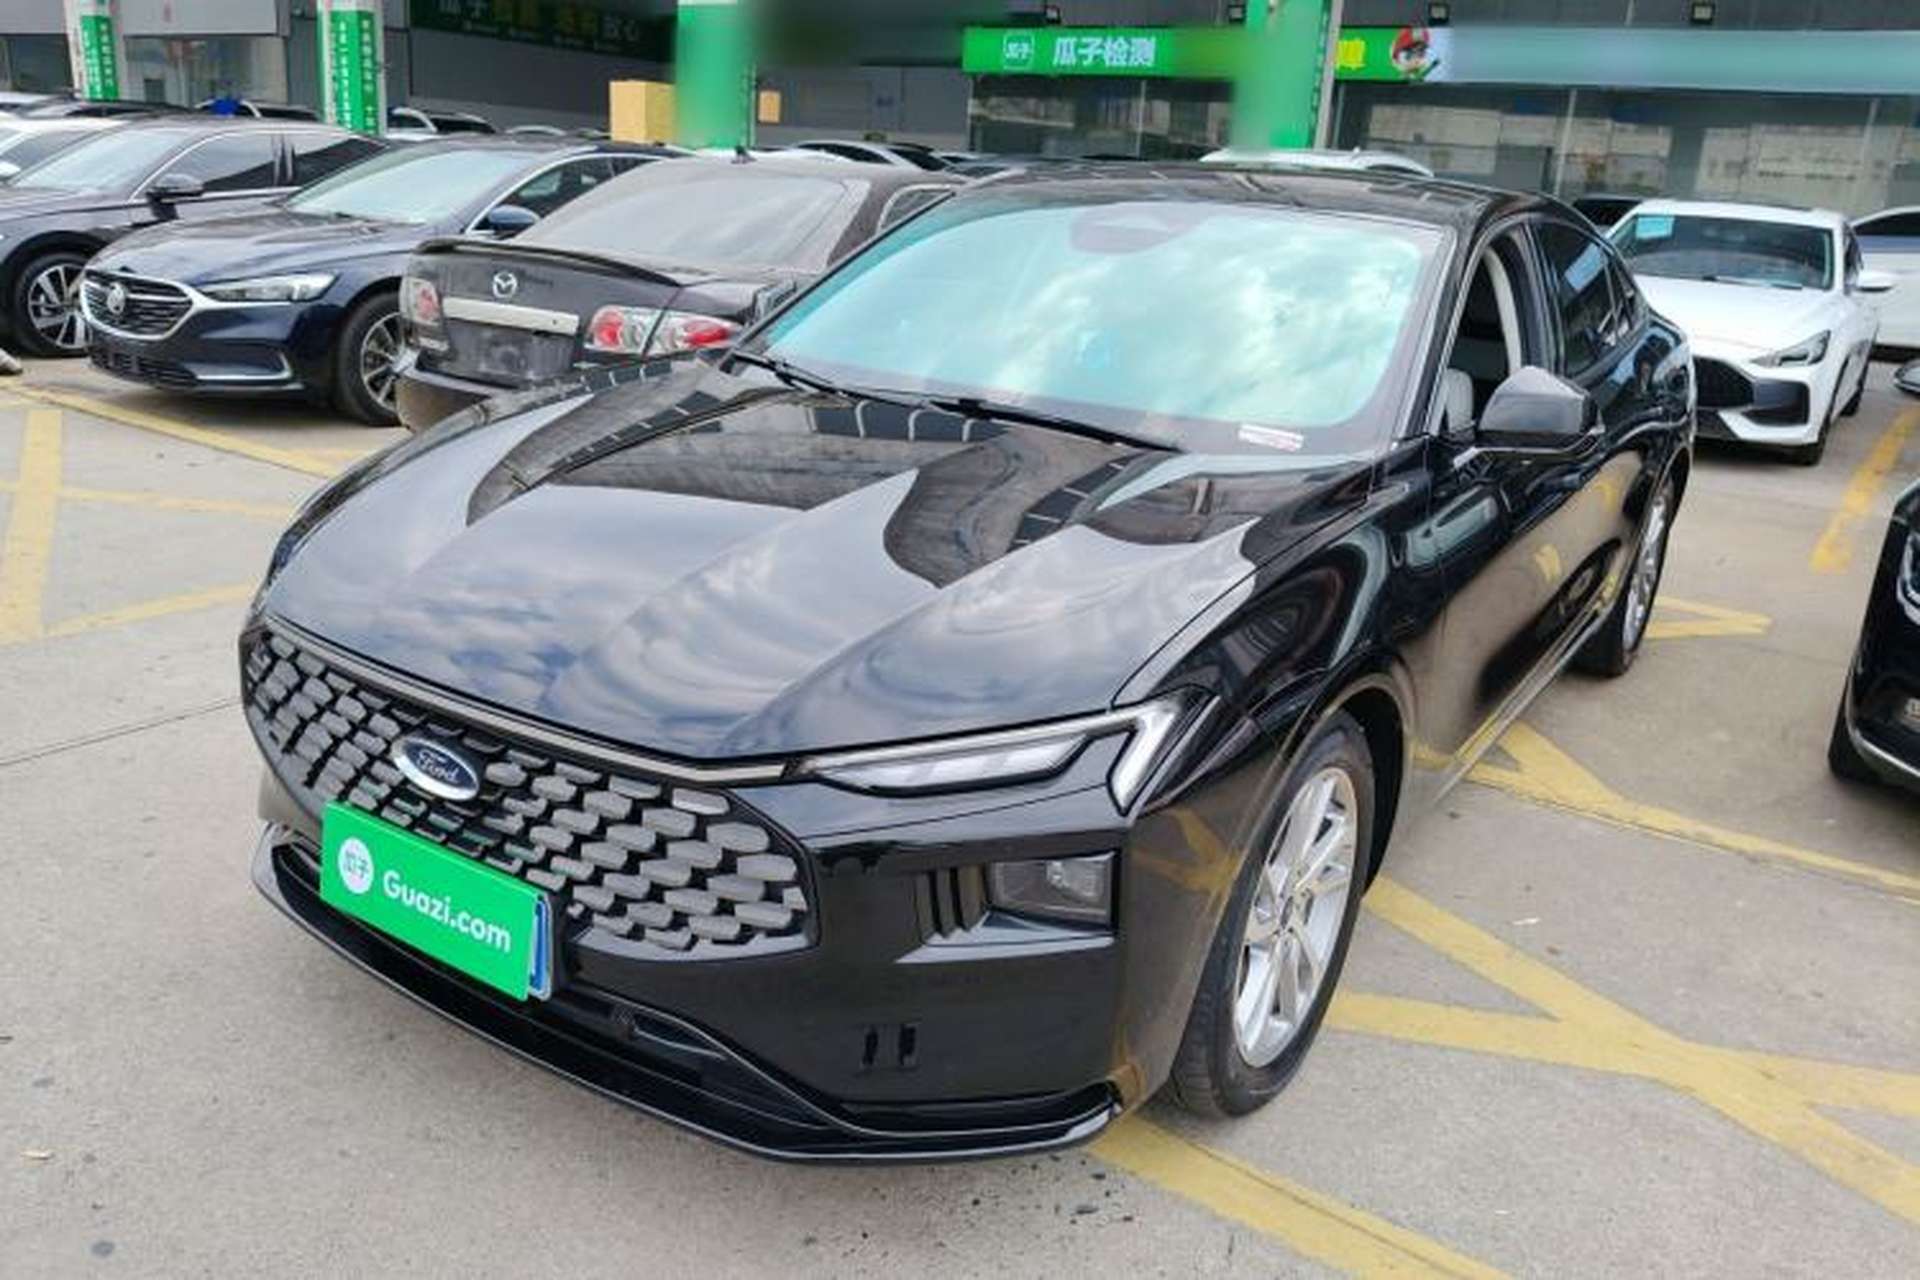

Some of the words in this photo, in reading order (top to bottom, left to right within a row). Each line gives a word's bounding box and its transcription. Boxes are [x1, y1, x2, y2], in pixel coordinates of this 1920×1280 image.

[1053, 36, 1157, 67] 瓜子检测
[416, 749, 459, 784] Ford
[383, 869, 511, 952] Guazi.com
